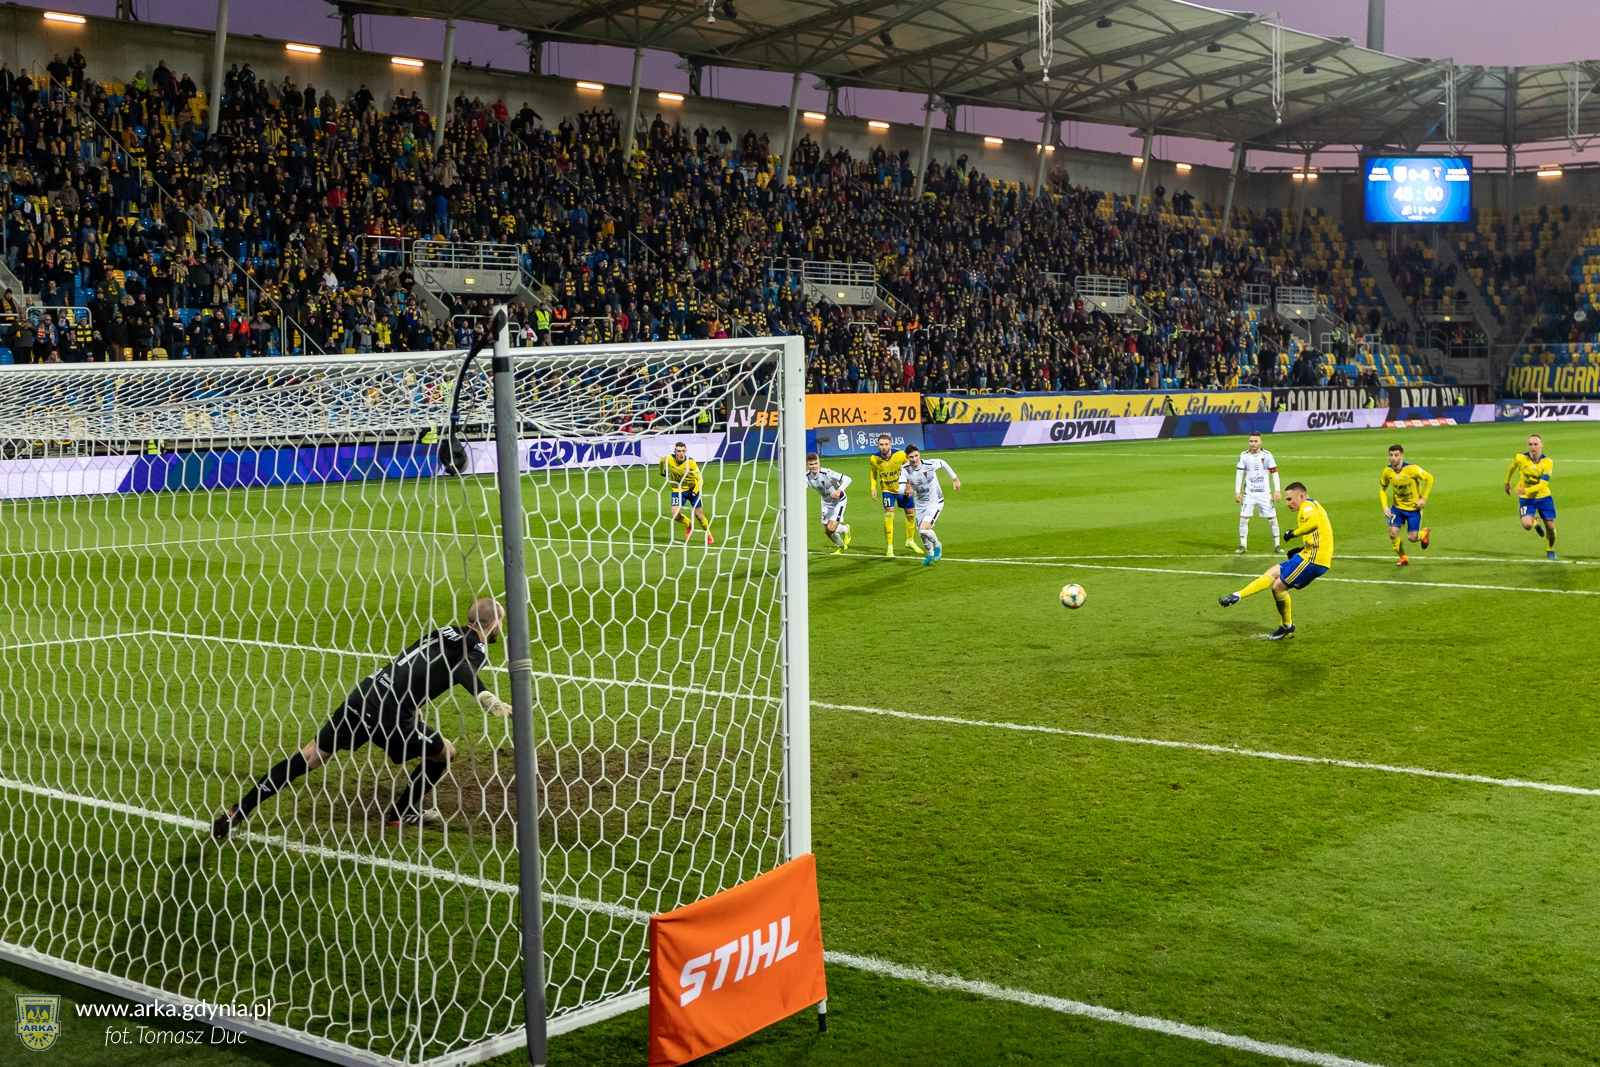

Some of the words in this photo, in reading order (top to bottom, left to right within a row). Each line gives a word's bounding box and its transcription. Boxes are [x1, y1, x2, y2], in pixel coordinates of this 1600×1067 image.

[498, 272, 512, 286] 15
[860, 287, 870, 300] 16
[1506, 365, 1600, 394] HOOLIGAN
[817, 407, 867, 425] ARKA:
[882, 405, 917, 424] 3,70
[1306, 411, 1354, 429] GDYNIA
[1522, 405, 1589, 419] DYNIA
[1049, 420, 1116, 442] GDYNIA
[526, 438, 642, 468] GDYNIA
[883, 497, 891, 507] 91
[1520, 505, 1528, 516] 17
[680, 915, 800, 1008] STIHL
